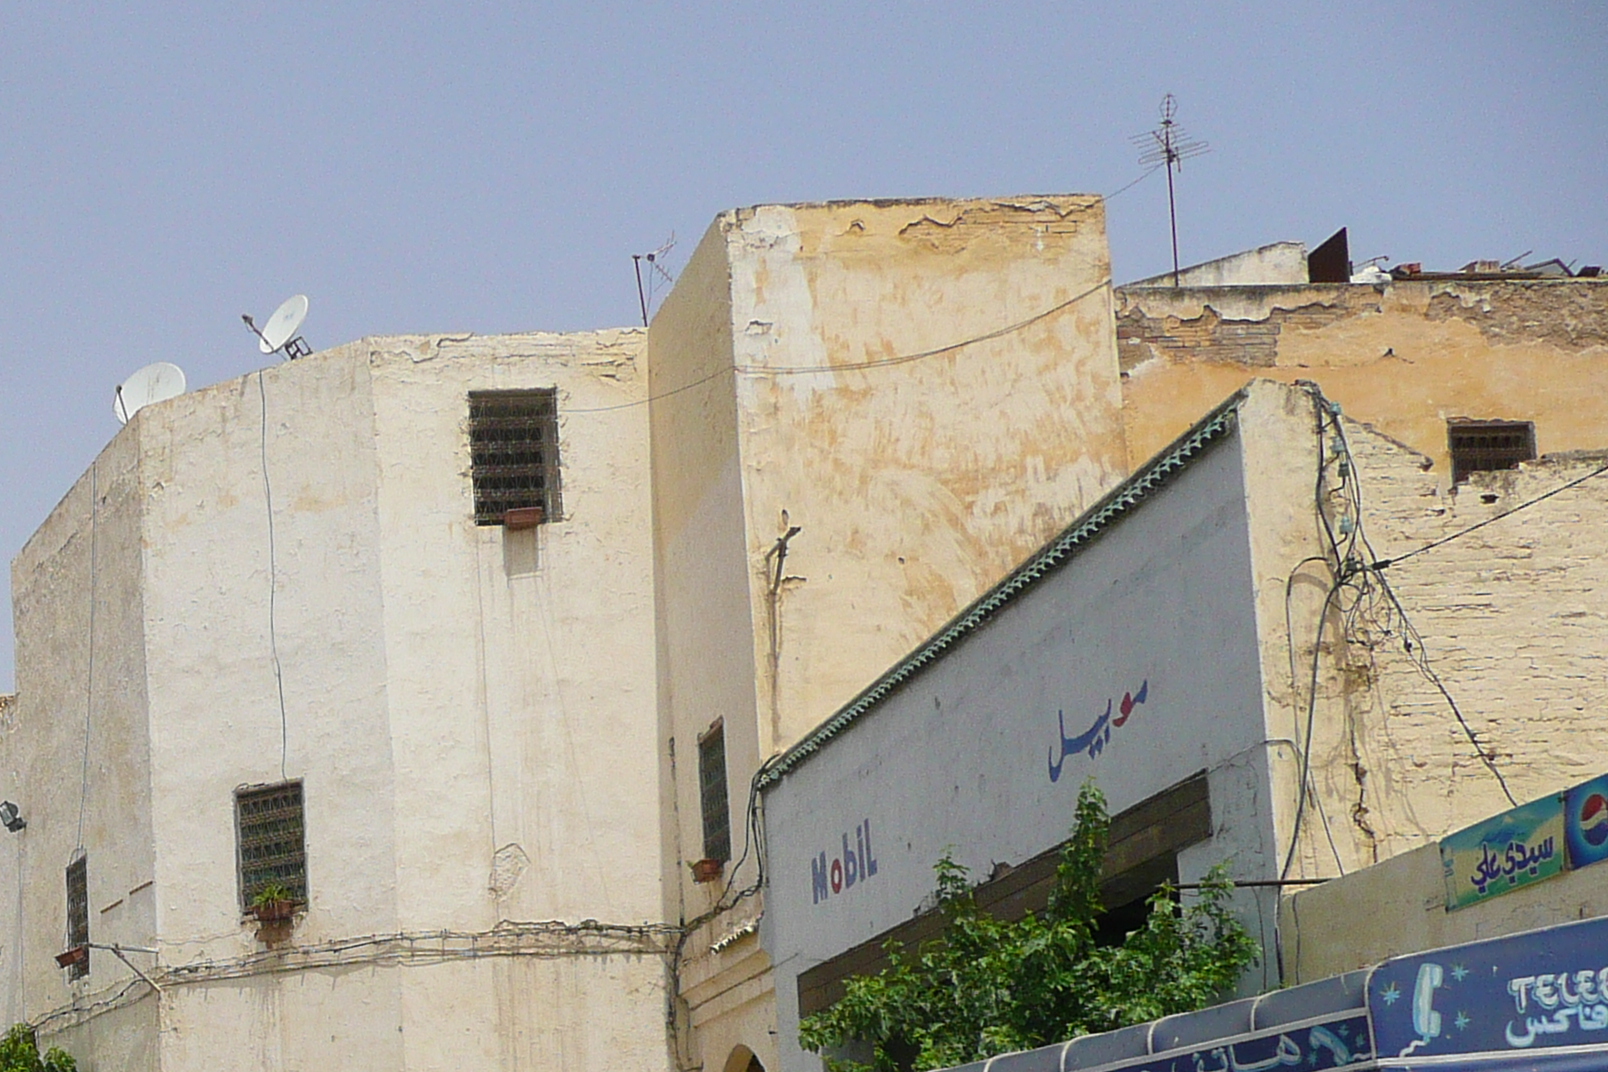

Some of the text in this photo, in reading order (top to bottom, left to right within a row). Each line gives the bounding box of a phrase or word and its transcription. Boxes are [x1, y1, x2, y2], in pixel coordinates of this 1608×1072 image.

[1048, 679, 1148, 782] موبيل
[1470, 841, 1502, 894] علي
[1502, 836, 1554, 885] سيدي
